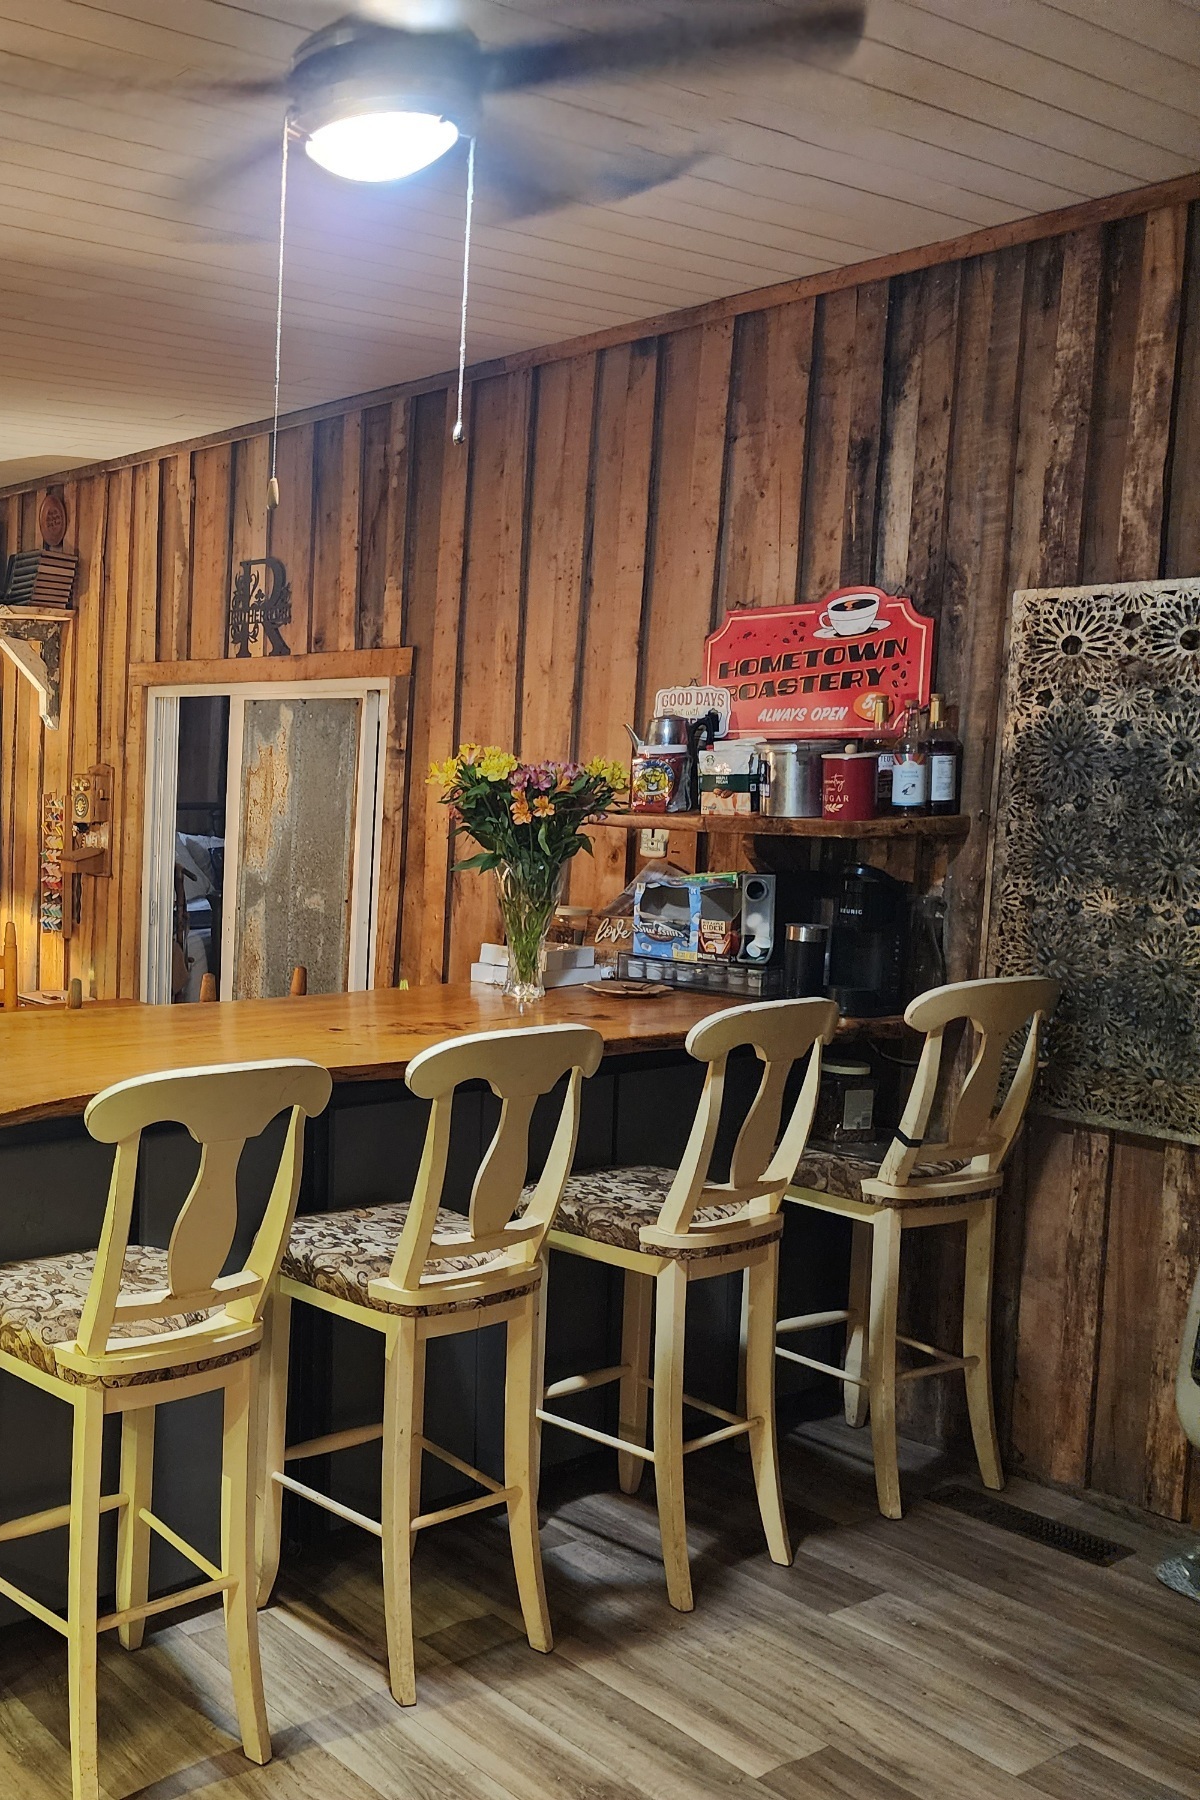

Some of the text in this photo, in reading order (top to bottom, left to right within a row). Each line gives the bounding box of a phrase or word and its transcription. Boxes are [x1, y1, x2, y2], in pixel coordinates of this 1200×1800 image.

[718, 637, 908, 681] HOMETOWN
[723, 666, 886, 702] ROASTERY
[661, 691, 725, 708] GOOD DAYS
[757, 707, 808, 723] ALWAYS
[810, 706, 849, 722] OPEN
[822, 794, 849, 803] UGAR
[839, 907, 863, 915] KEURIG
[702, 924, 724, 932] CIDER
